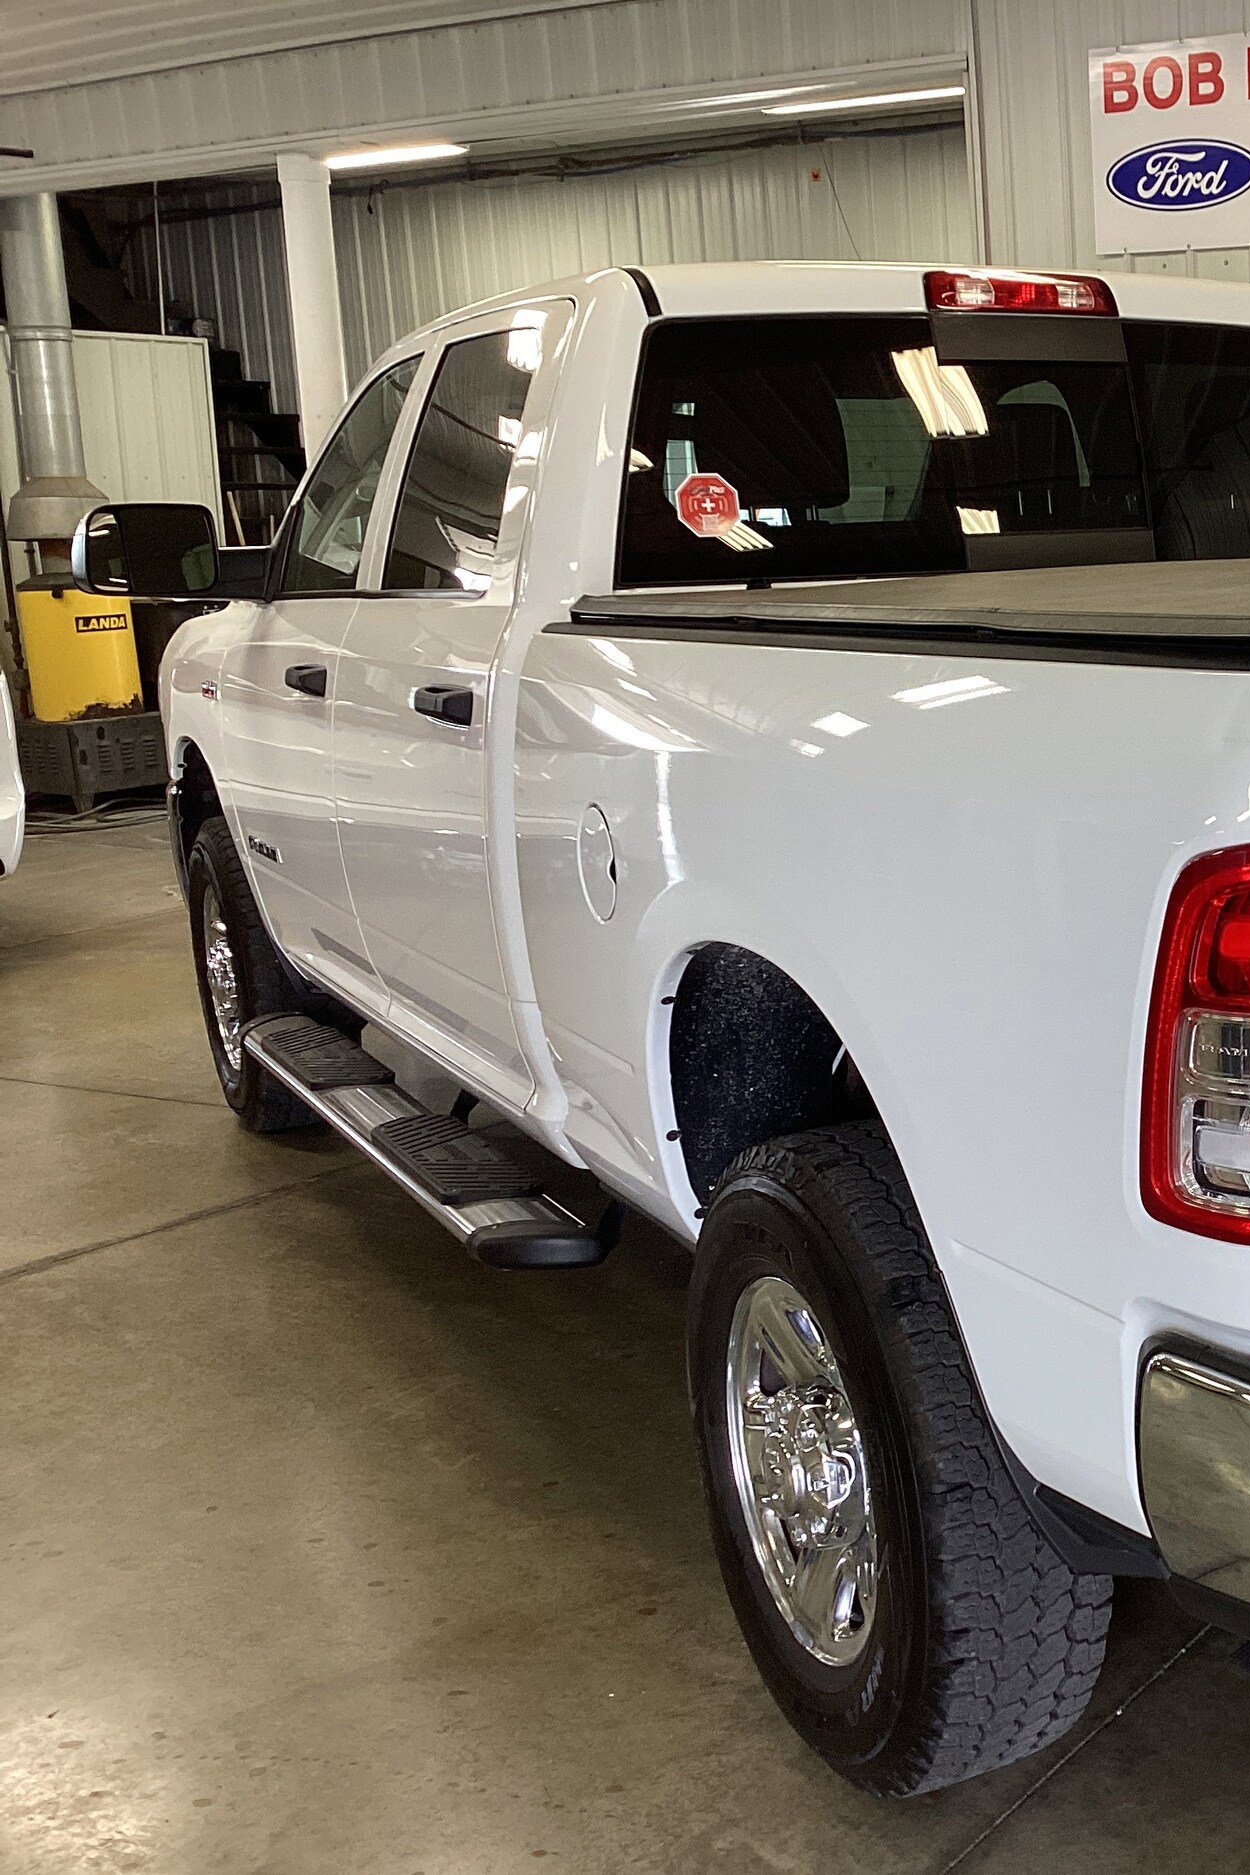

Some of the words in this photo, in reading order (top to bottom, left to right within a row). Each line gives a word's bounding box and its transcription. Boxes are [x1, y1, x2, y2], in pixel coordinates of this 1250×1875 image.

[1103, 51, 1225, 114] BOB
[1137, 151, 1228, 200] Ford
[77, 616, 126, 631] LANDA
